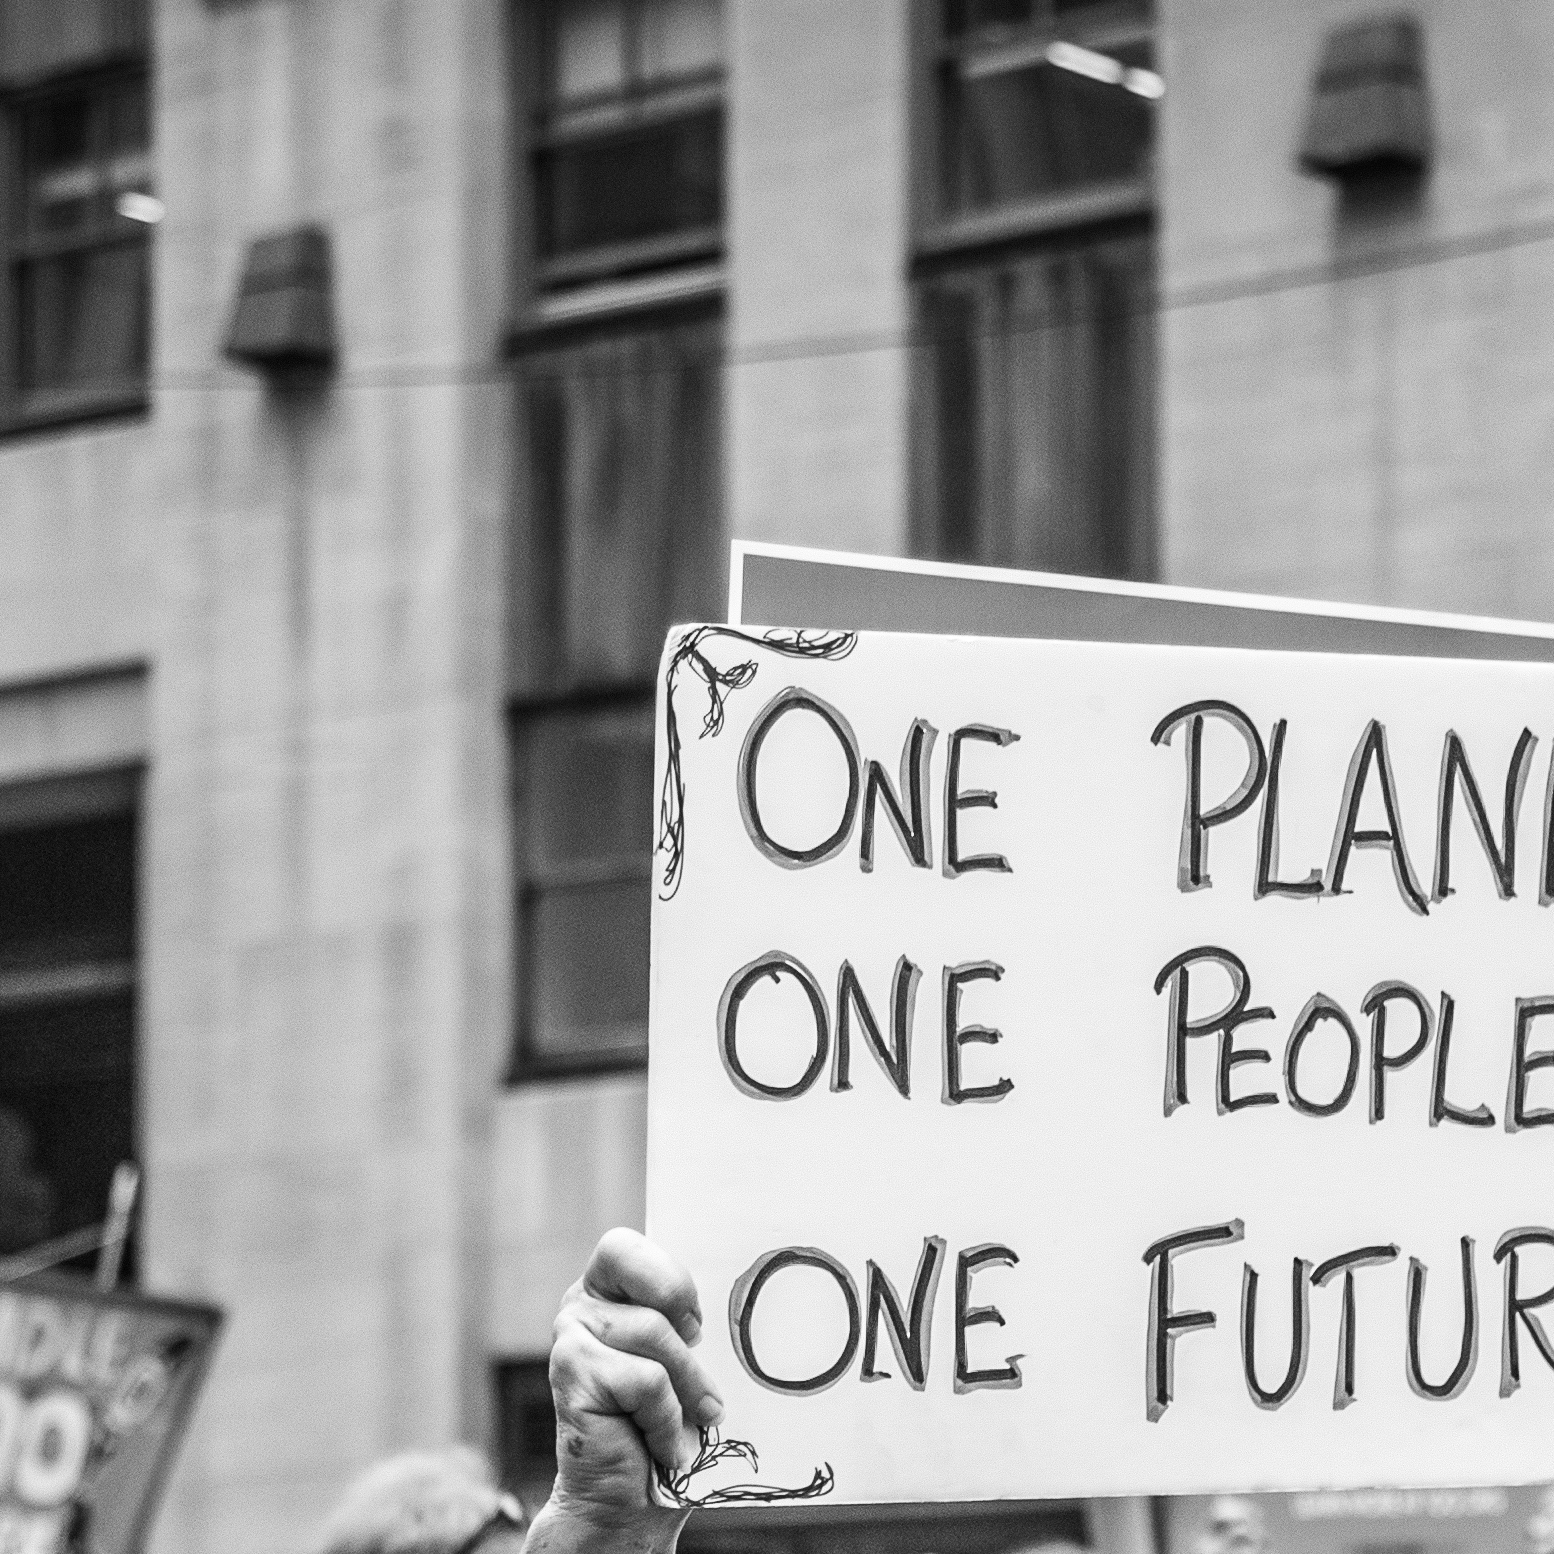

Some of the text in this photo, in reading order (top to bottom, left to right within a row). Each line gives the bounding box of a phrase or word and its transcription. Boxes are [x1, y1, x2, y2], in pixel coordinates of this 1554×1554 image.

[736, 686, 1021, 876] ONE
[716, 950, 1015, 1105] ONE
[729, 1236, 1027, 1397] ONE
